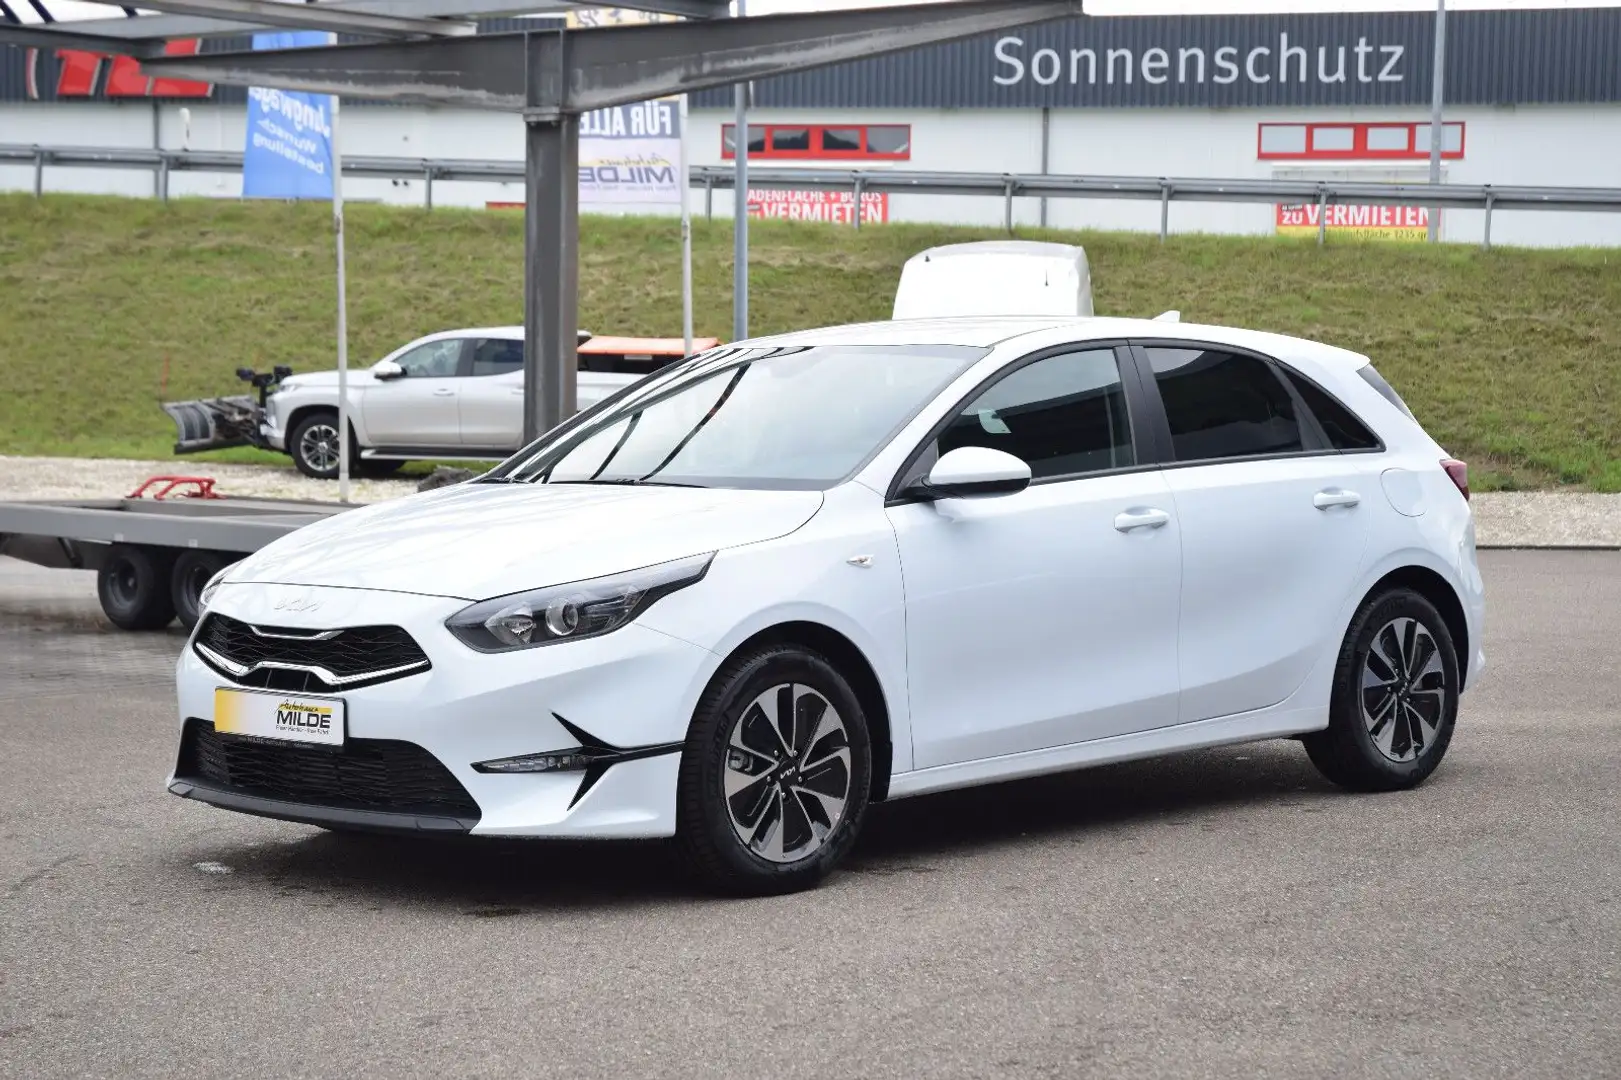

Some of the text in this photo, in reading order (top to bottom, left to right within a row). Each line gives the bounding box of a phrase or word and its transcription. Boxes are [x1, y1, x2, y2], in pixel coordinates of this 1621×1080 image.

[993, 32, 1405, 86] Sonnenschutz
[1282, 211, 1303, 224] ZU
[276, 710, 332, 729] MILDE
